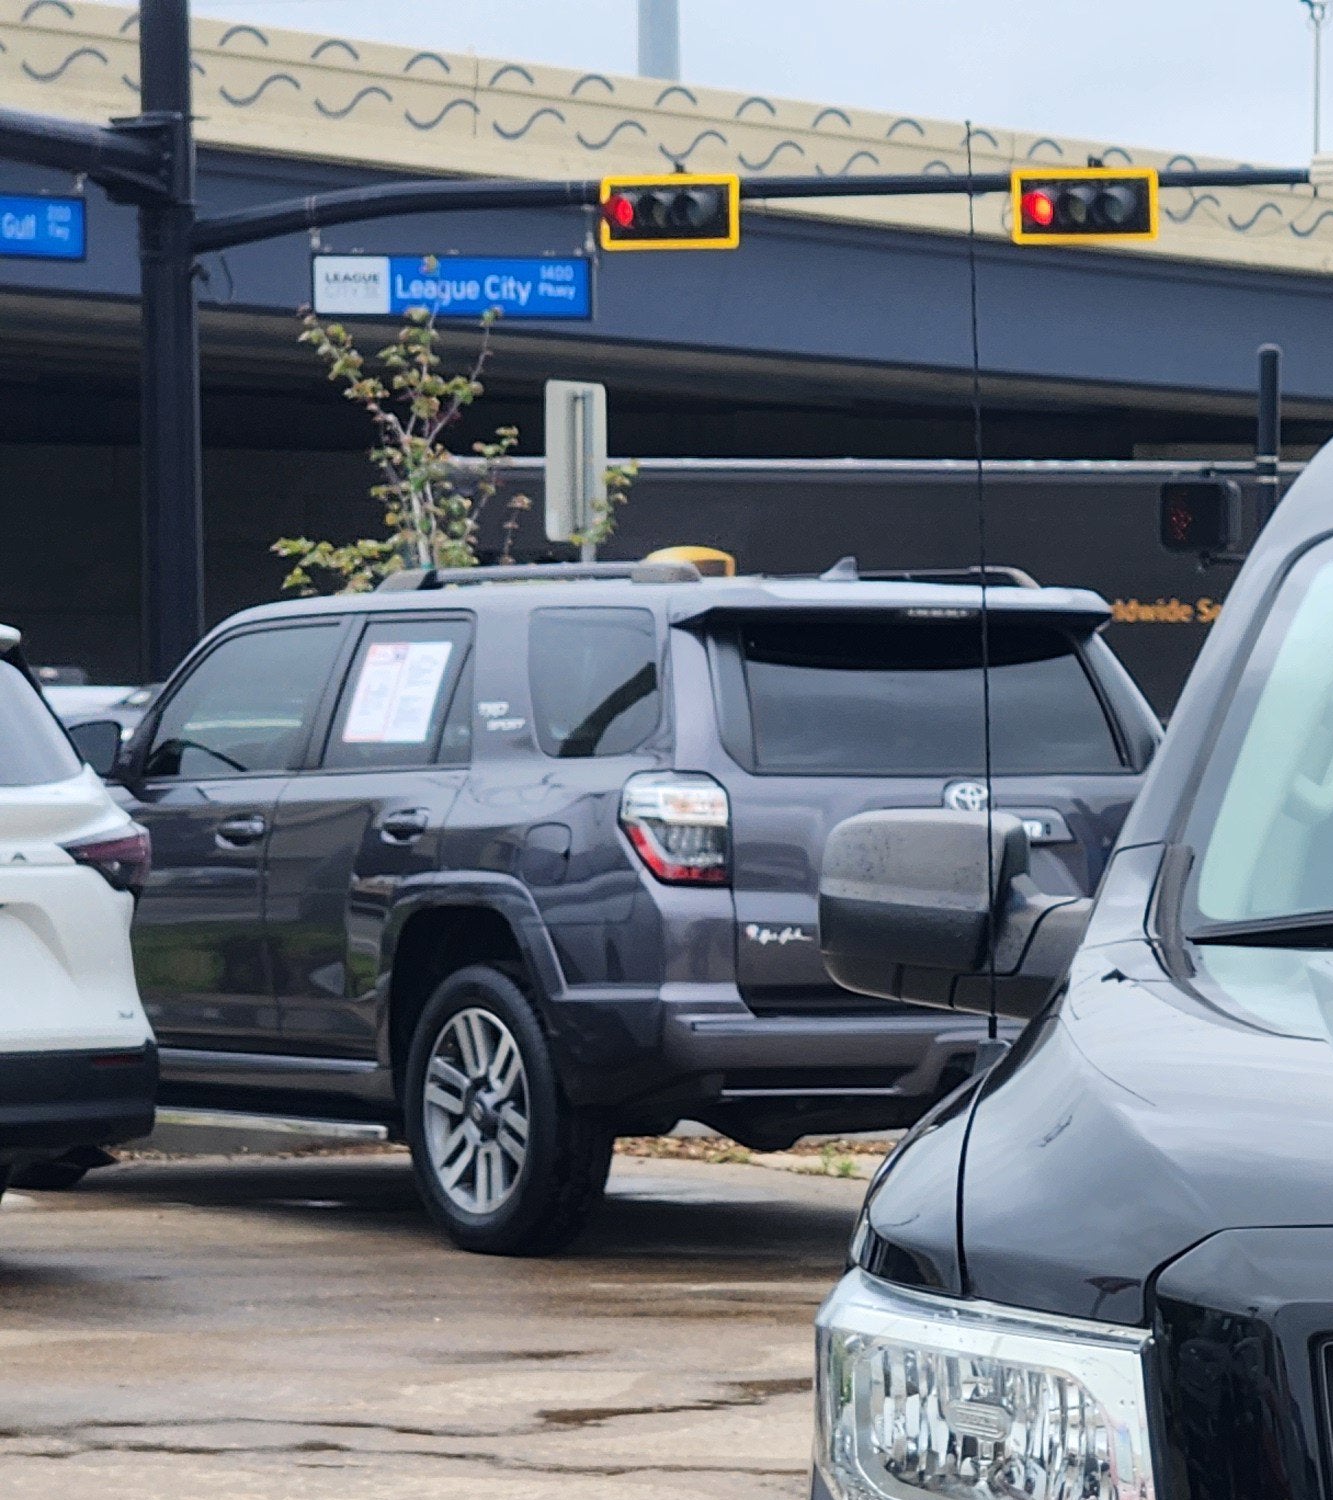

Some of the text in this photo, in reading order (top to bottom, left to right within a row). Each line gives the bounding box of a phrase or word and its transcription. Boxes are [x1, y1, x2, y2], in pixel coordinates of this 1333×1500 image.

[324, 272, 379, 285] LEAGUE
[395, 273, 532, 307] League City
[1110, 598, 1194, 622] ldwide
